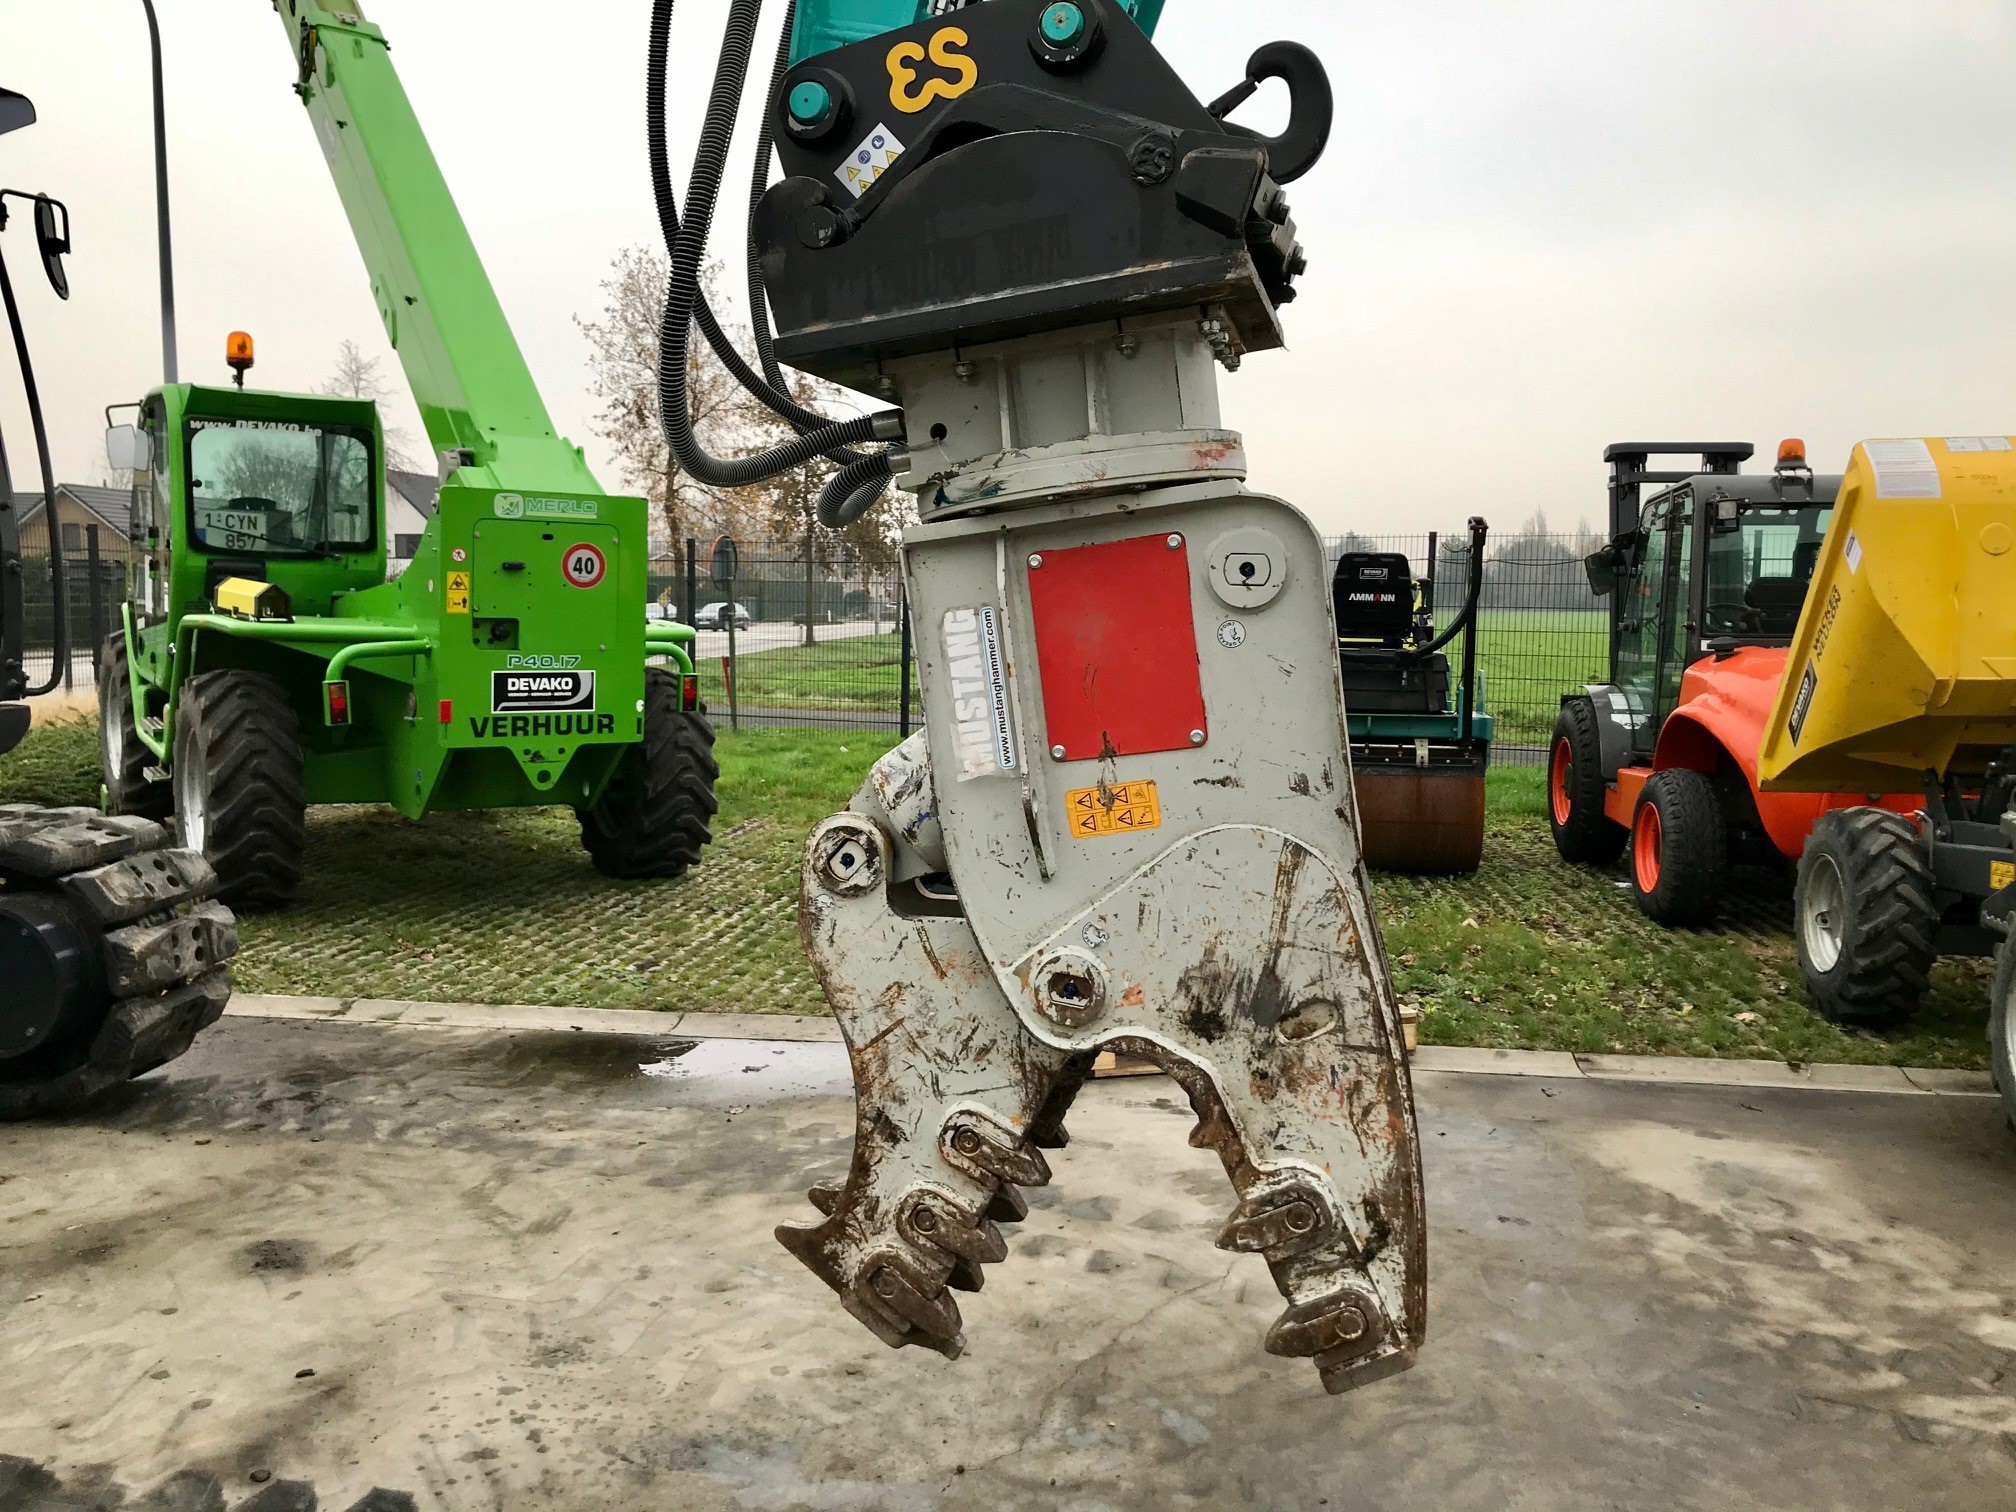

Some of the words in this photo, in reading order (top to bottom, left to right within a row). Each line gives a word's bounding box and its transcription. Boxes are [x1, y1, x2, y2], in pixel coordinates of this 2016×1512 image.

[525, 498, 597, 514] MERLO
[225, 533, 257, 550] 857
[573, 557, 595, 575] 40
[1348, 593, 1396, 602] AMMANN
[507, 654, 581, 669] P40.17
[507, 677, 573, 691] DEVAKO
[983, 610, 1012, 766] www.mustanghammer.com
[469, 713, 615, 738] VERHUUR
